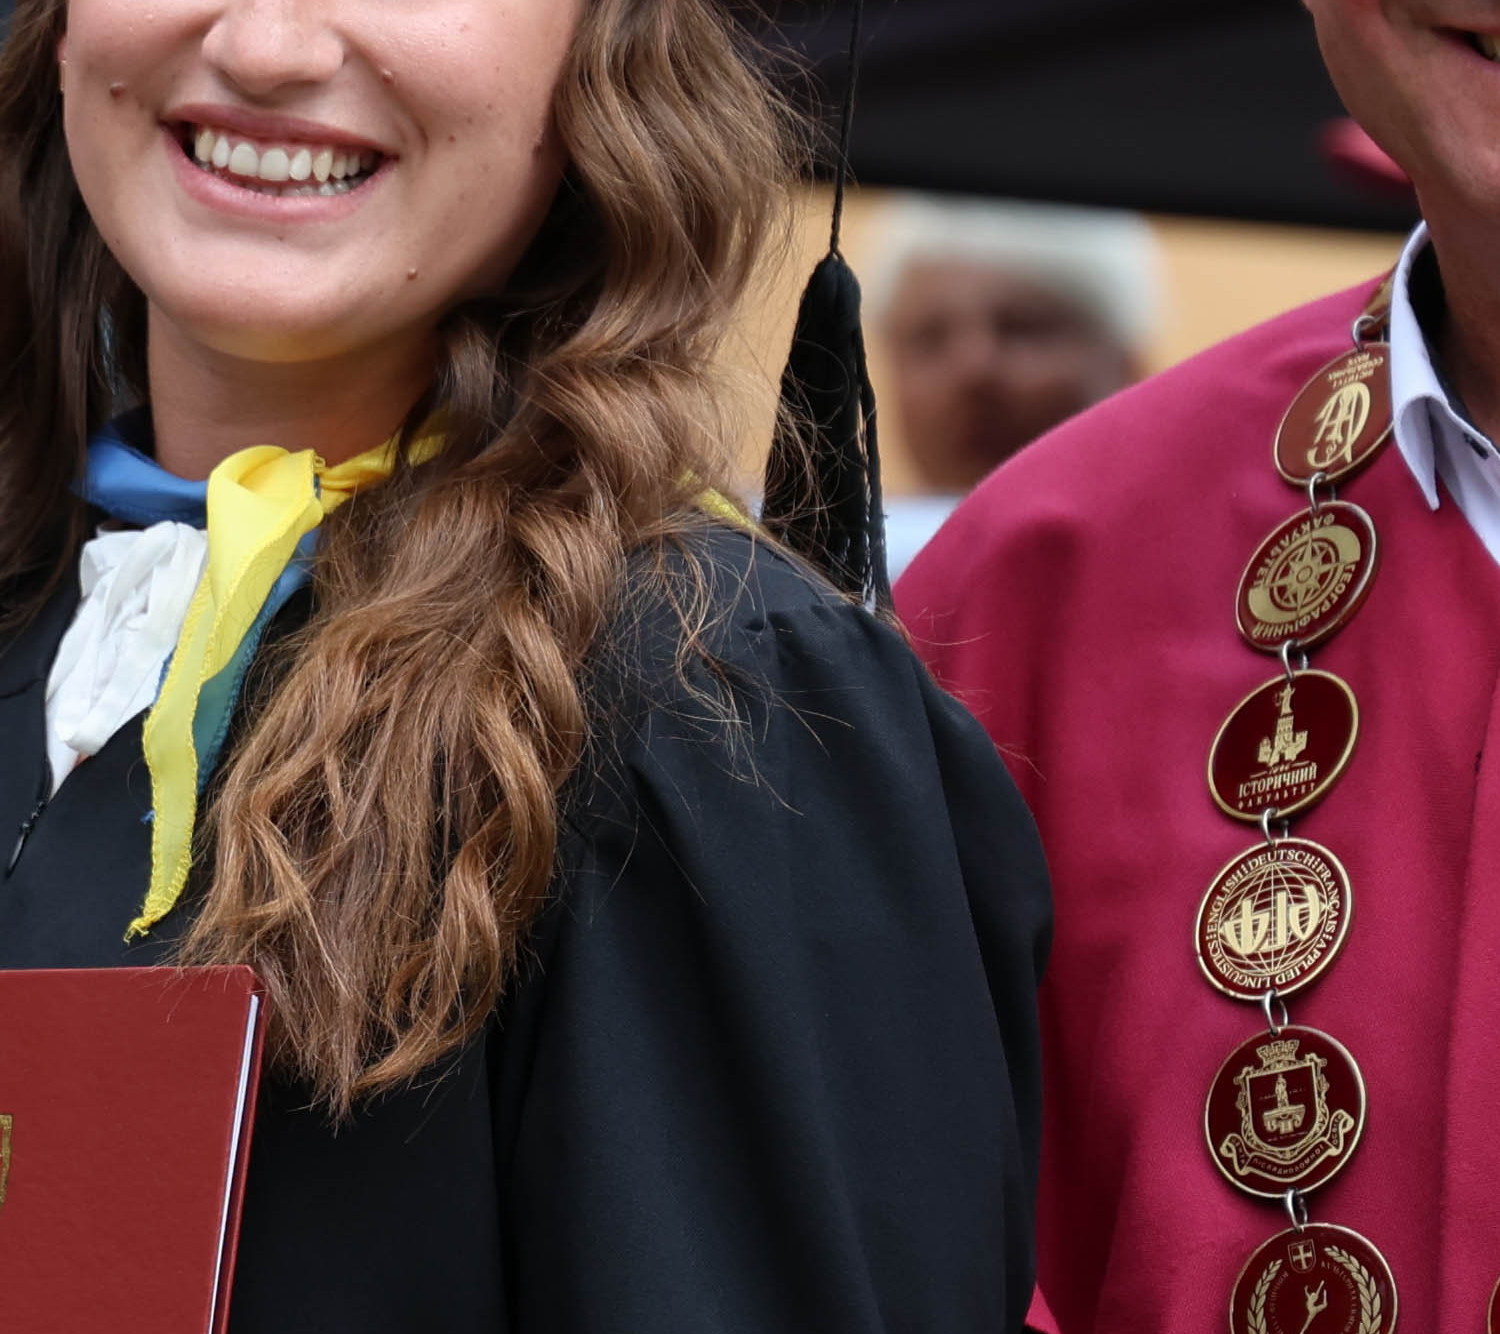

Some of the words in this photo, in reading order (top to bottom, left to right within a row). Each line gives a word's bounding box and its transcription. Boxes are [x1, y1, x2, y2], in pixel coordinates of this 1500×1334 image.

[1253, 512, 1336, 588] ФАКУЛЬТЕТ
[1252, 563, 1357, 639] ГЕОГРАФІЧНИЙ
[1238, 762, 1319, 799] ІСТОРИЧНИЙ
[1238, 782, 1317, 810] ФАКУЛЬТЕТ
[1248, 849, 1315, 871] DEUTSCH
[1207, 870, 1245, 932] ENGLISH
[1207, 941, 1271, 988] LINGUISTICS
[1275, 941, 1327, 985] APPLIED
